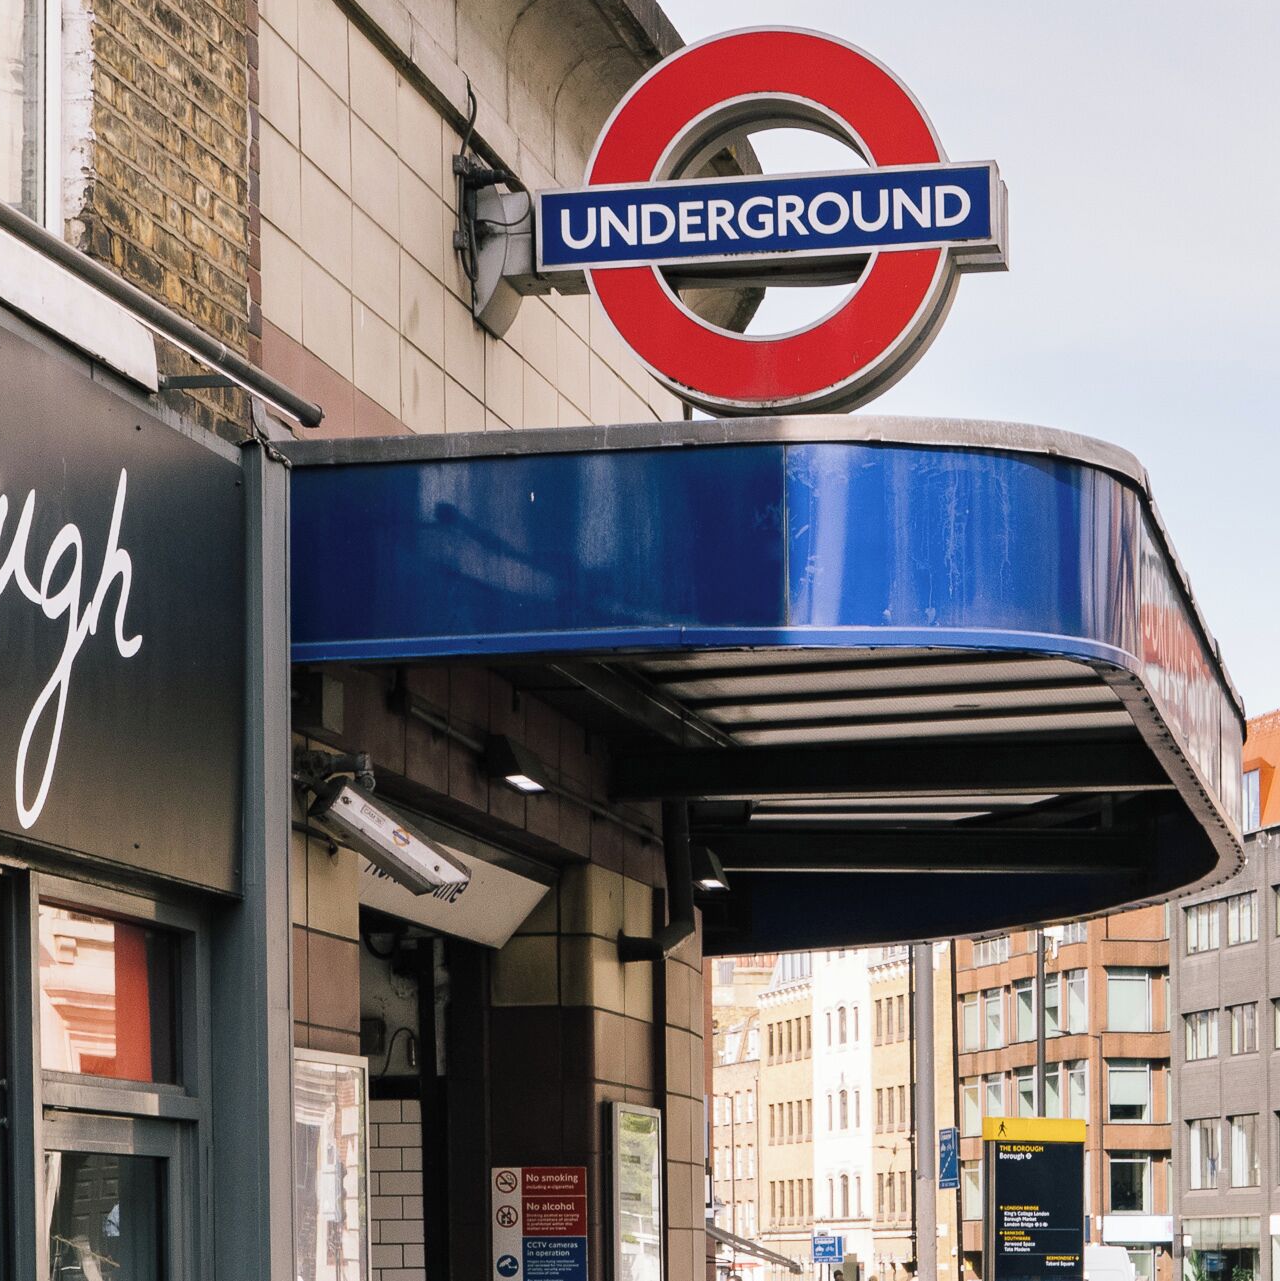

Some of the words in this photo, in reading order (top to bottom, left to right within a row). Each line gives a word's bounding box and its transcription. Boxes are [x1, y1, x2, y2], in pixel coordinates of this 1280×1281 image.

[560, 184, 972, 250] UNDERGROUND
[999, 1152, 1025, 1160] Borough
[526, 1173, 539, 1182] No
[541, 1173, 578, 1184] smoking
[526, 1202, 540, 1211] No
[542, 1202, 574, 1211] alcohol
